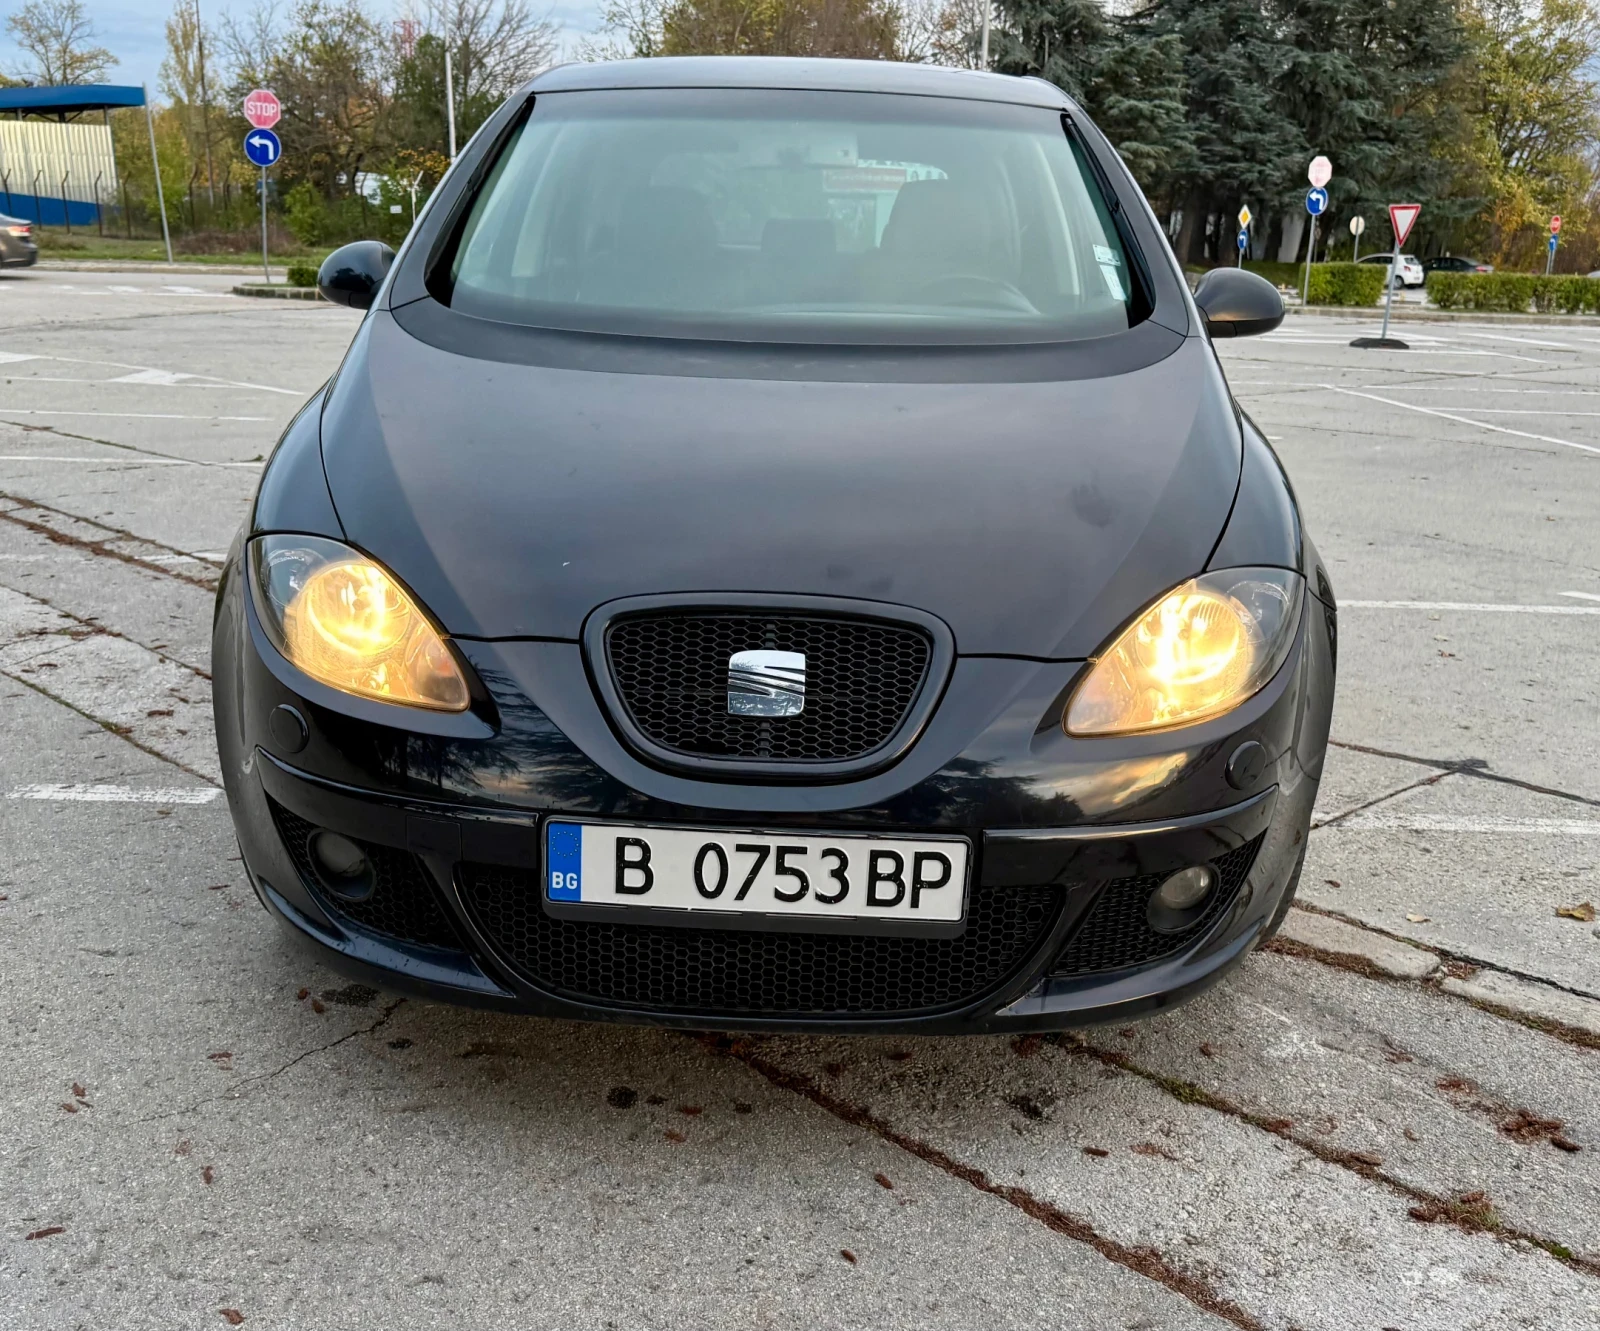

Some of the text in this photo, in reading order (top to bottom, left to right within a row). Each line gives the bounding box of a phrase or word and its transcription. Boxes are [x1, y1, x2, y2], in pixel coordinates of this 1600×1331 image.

[247, 102, 277, 117] STOP
[552, 871, 578, 890] BG
[615, 836, 952, 909] B 0753 BP
